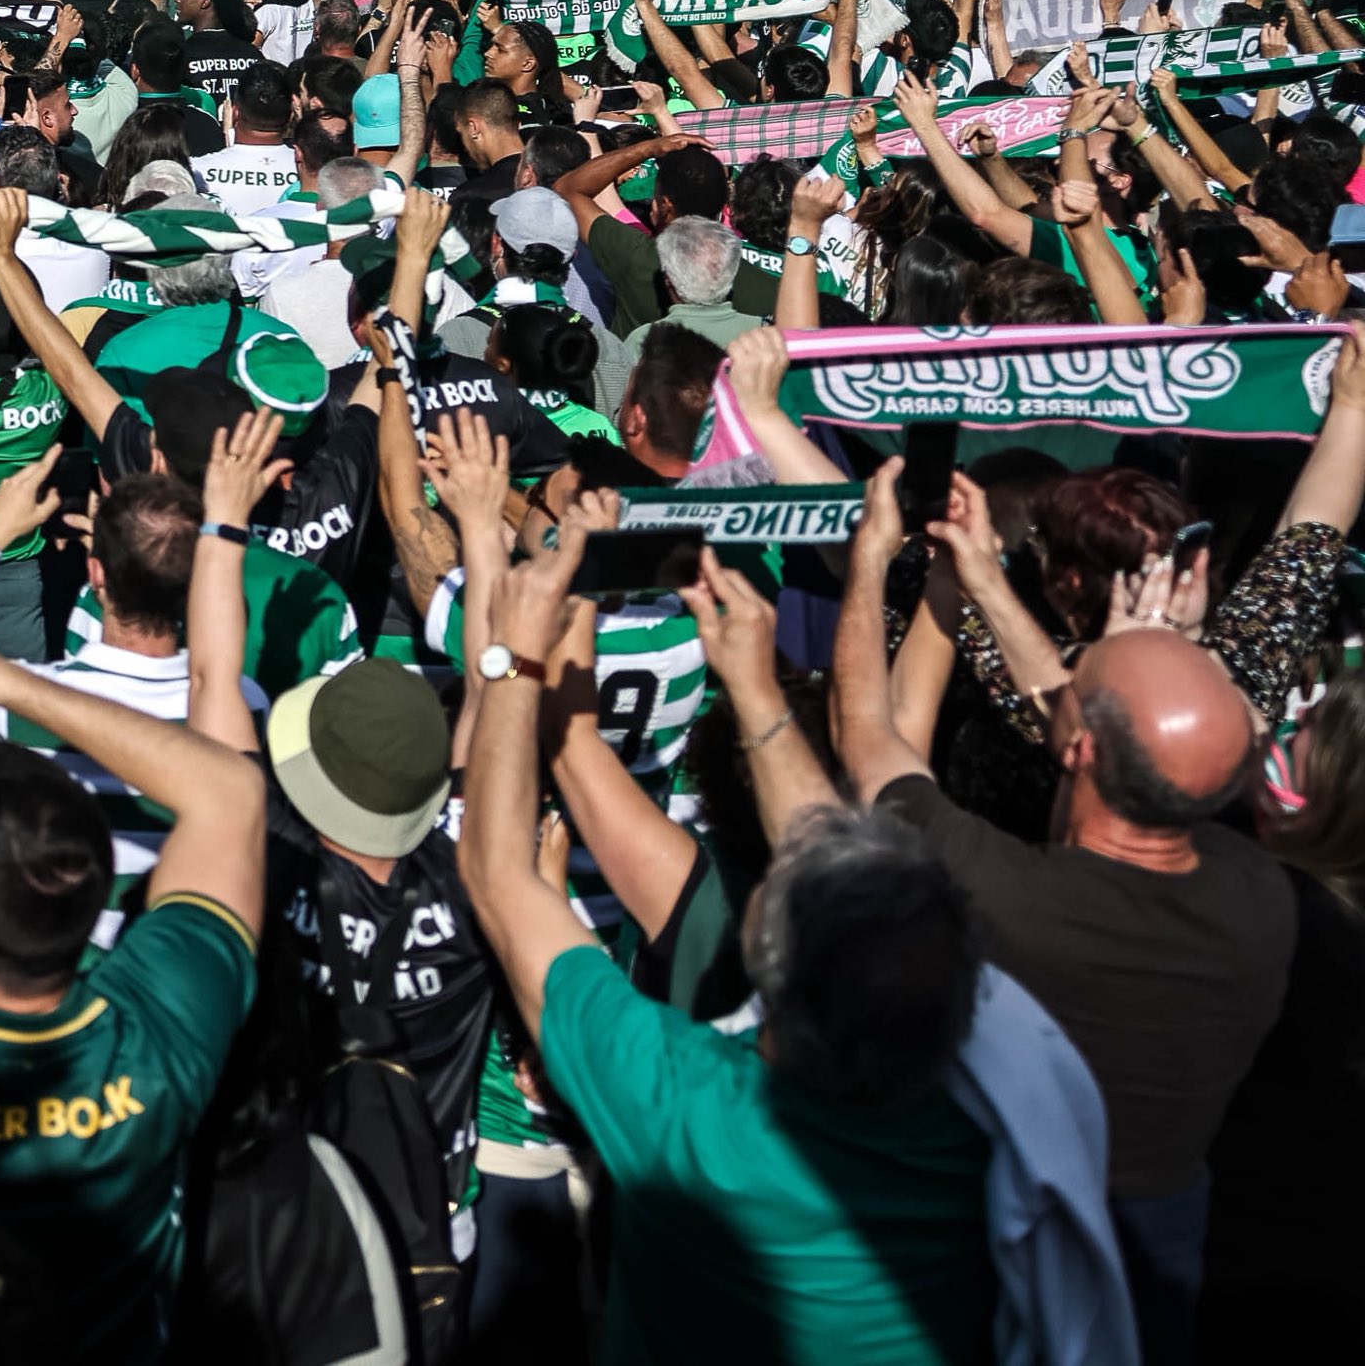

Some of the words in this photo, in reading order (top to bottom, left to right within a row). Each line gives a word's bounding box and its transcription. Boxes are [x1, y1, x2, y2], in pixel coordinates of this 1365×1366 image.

[189, 58, 229, 74] SUPER
[205, 168, 268, 186] SUPER
[439, 378, 499, 407] BOCK
